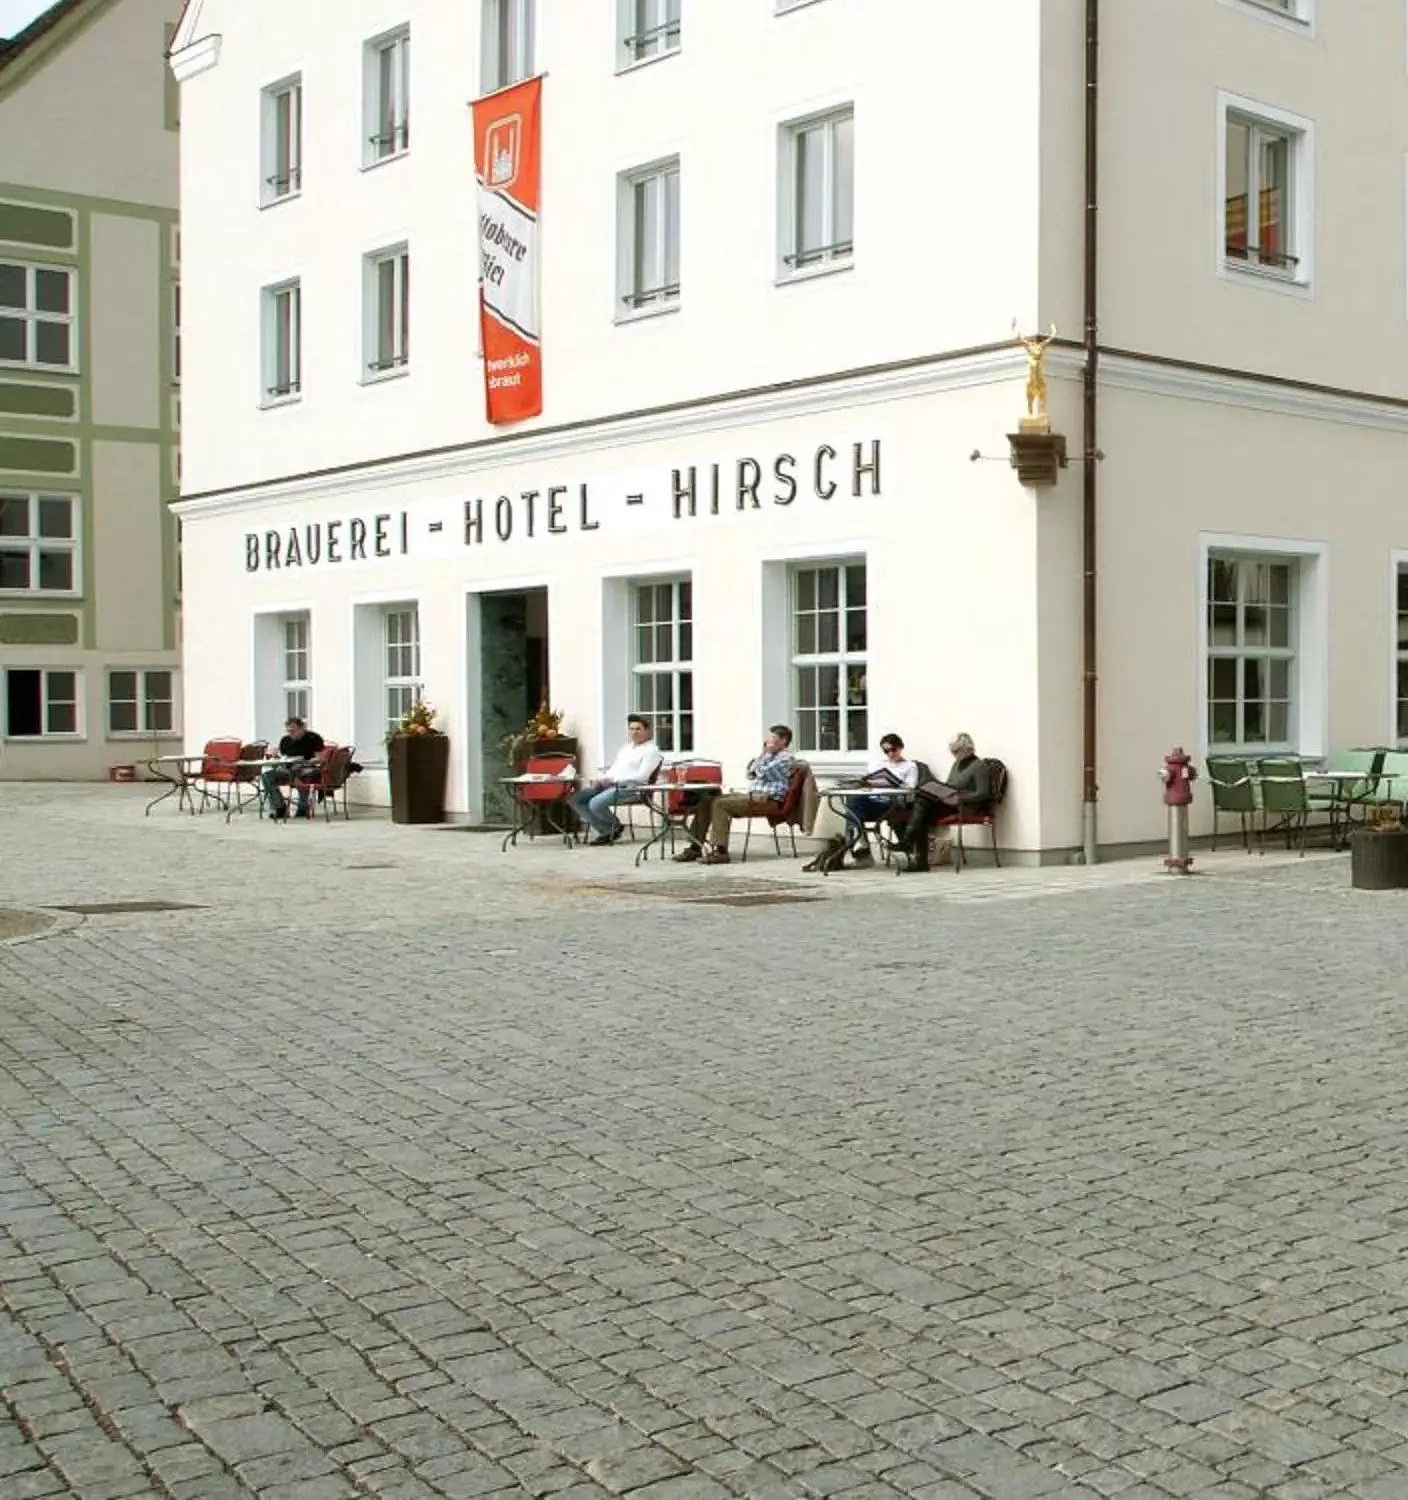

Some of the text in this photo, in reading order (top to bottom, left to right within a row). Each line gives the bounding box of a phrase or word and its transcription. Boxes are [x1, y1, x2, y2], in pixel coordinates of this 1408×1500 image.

[245, 510, 408, 573] BRAUEREI
[463, 483, 600, 546] HOTEL
[671, 439, 882, 519] HIRSCH
